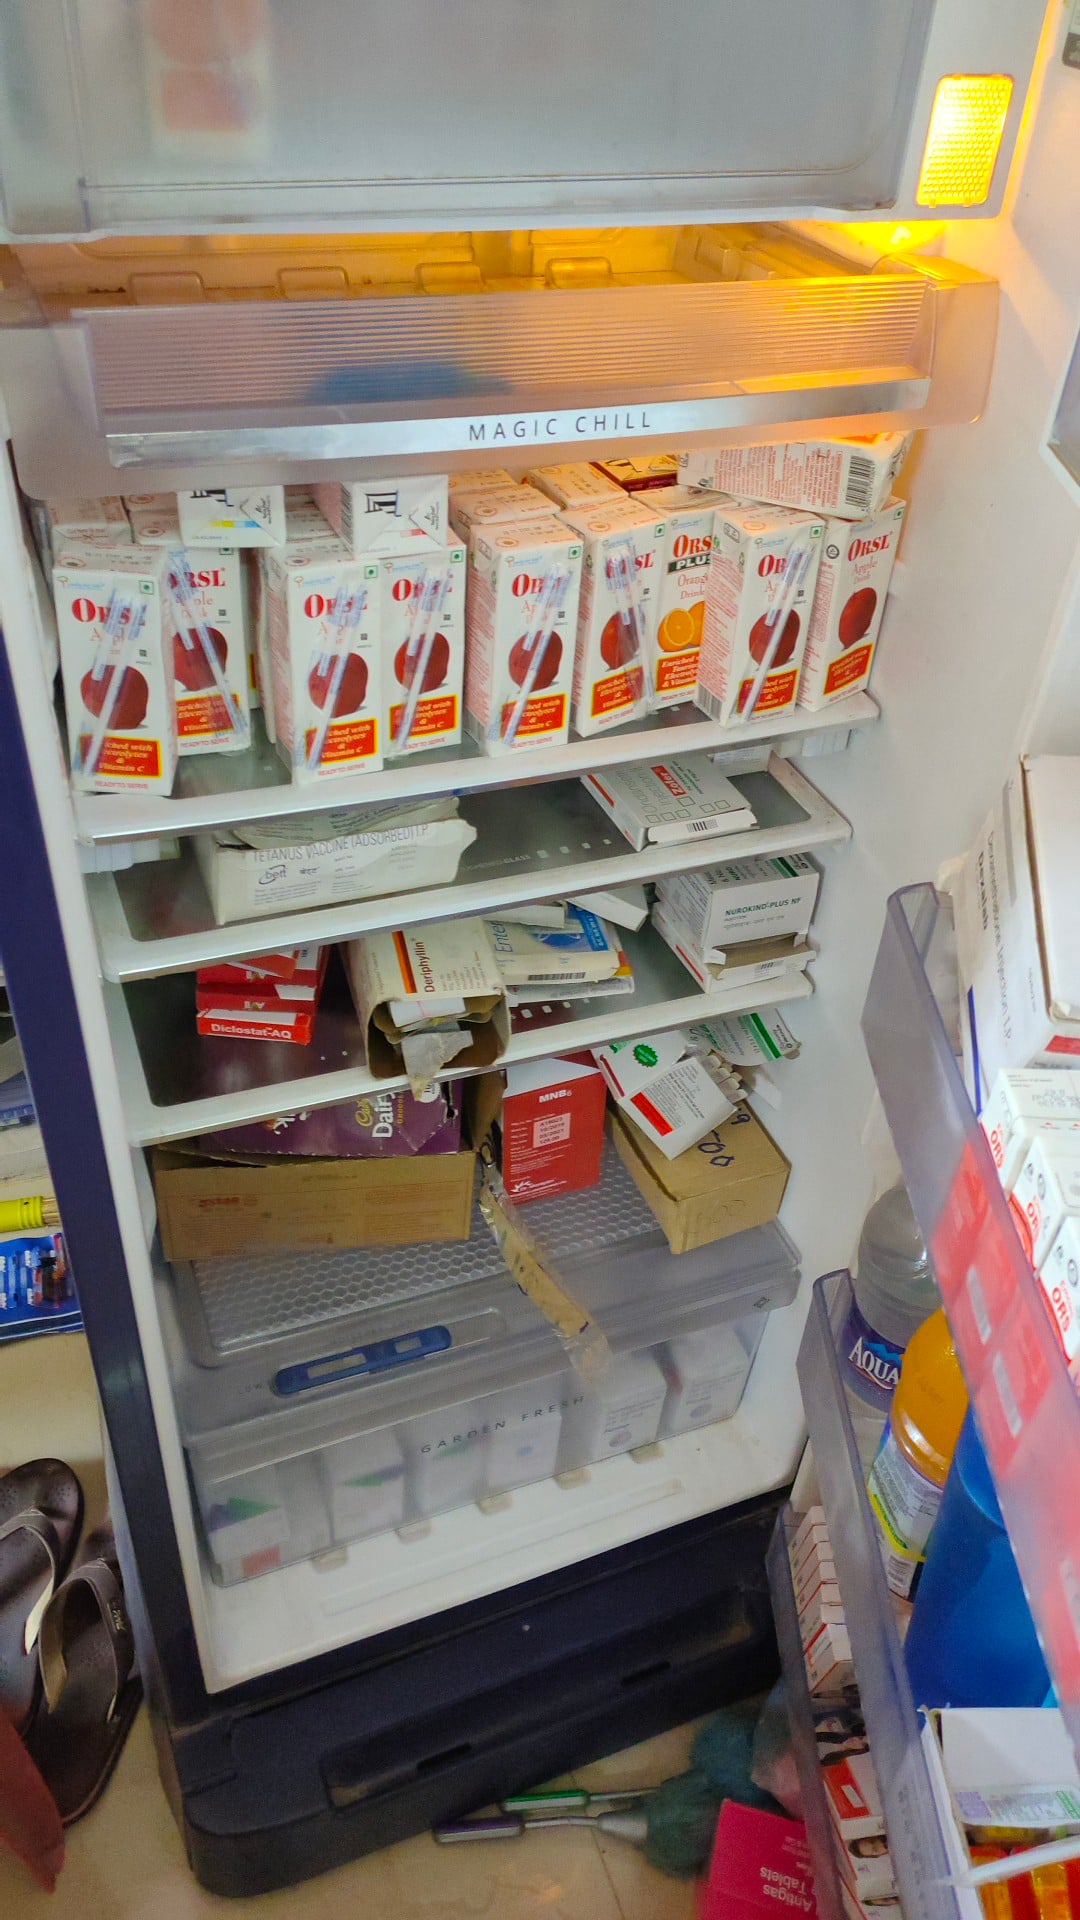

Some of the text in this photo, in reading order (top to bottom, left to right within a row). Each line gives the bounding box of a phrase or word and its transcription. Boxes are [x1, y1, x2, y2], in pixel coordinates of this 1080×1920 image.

[468, 411, 651, 442] MAGIC CHILL
[847, 534, 891, 563] ORSL
[254, 846, 304, 864] TETANUS
[418, 940, 435, 993] Deriphyllin
[210, 1022, 293, 1041] Diclostat-AQ
[1052, 1286, 1070, 1334] ORS
[847, 1336, 901, 1390] AQUA
[420, 1395, 585, 1454] GARDEN FRESH
[759, 1864, 808, 1900] Tablets
[761, 1883, 814, 1914] Antigas
